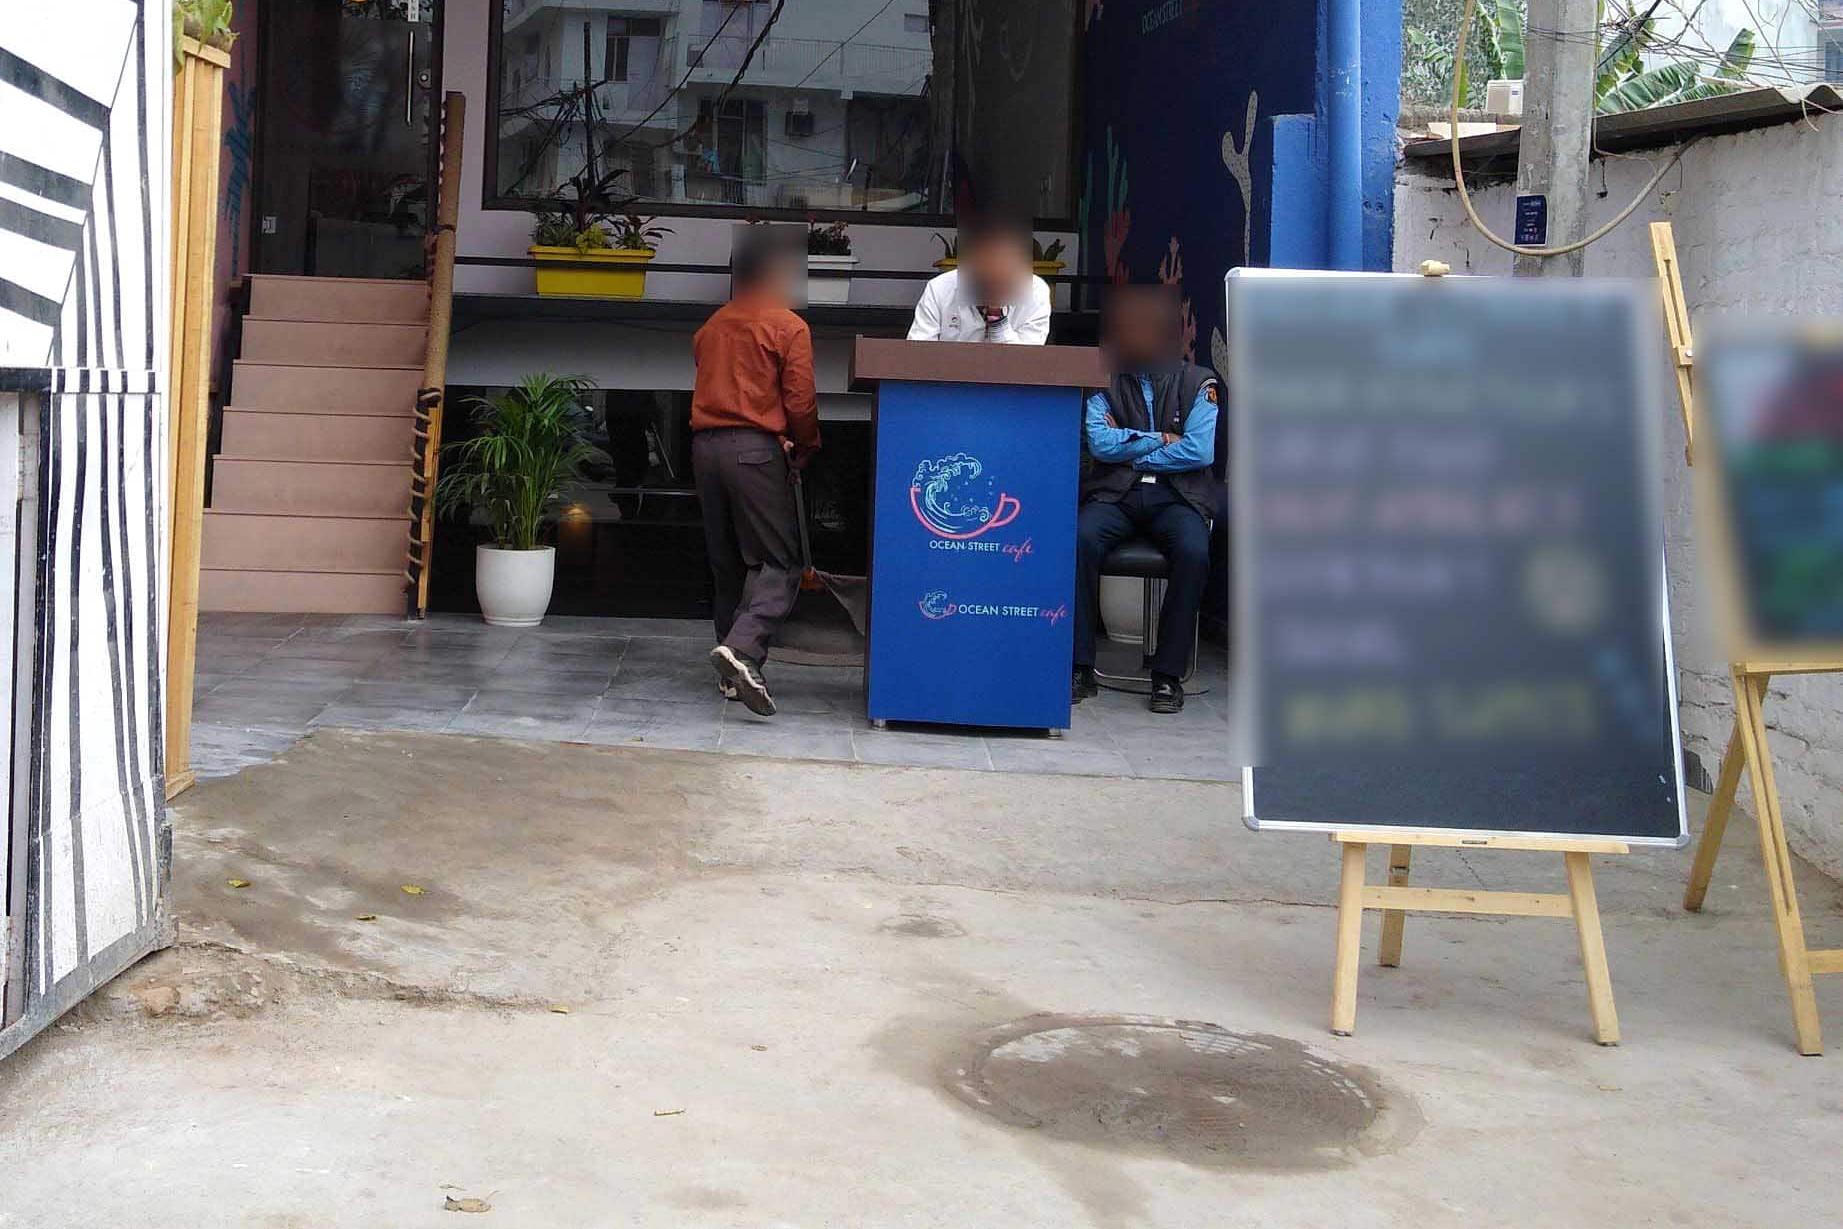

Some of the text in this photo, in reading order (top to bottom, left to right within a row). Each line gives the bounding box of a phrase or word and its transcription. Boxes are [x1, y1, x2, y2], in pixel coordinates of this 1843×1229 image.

[929, 536, 1033, 563] OCEAN STREET cafe
[958, 604, 999, 615] OCEAN
[1002, 605, 1039, 617] STREET
